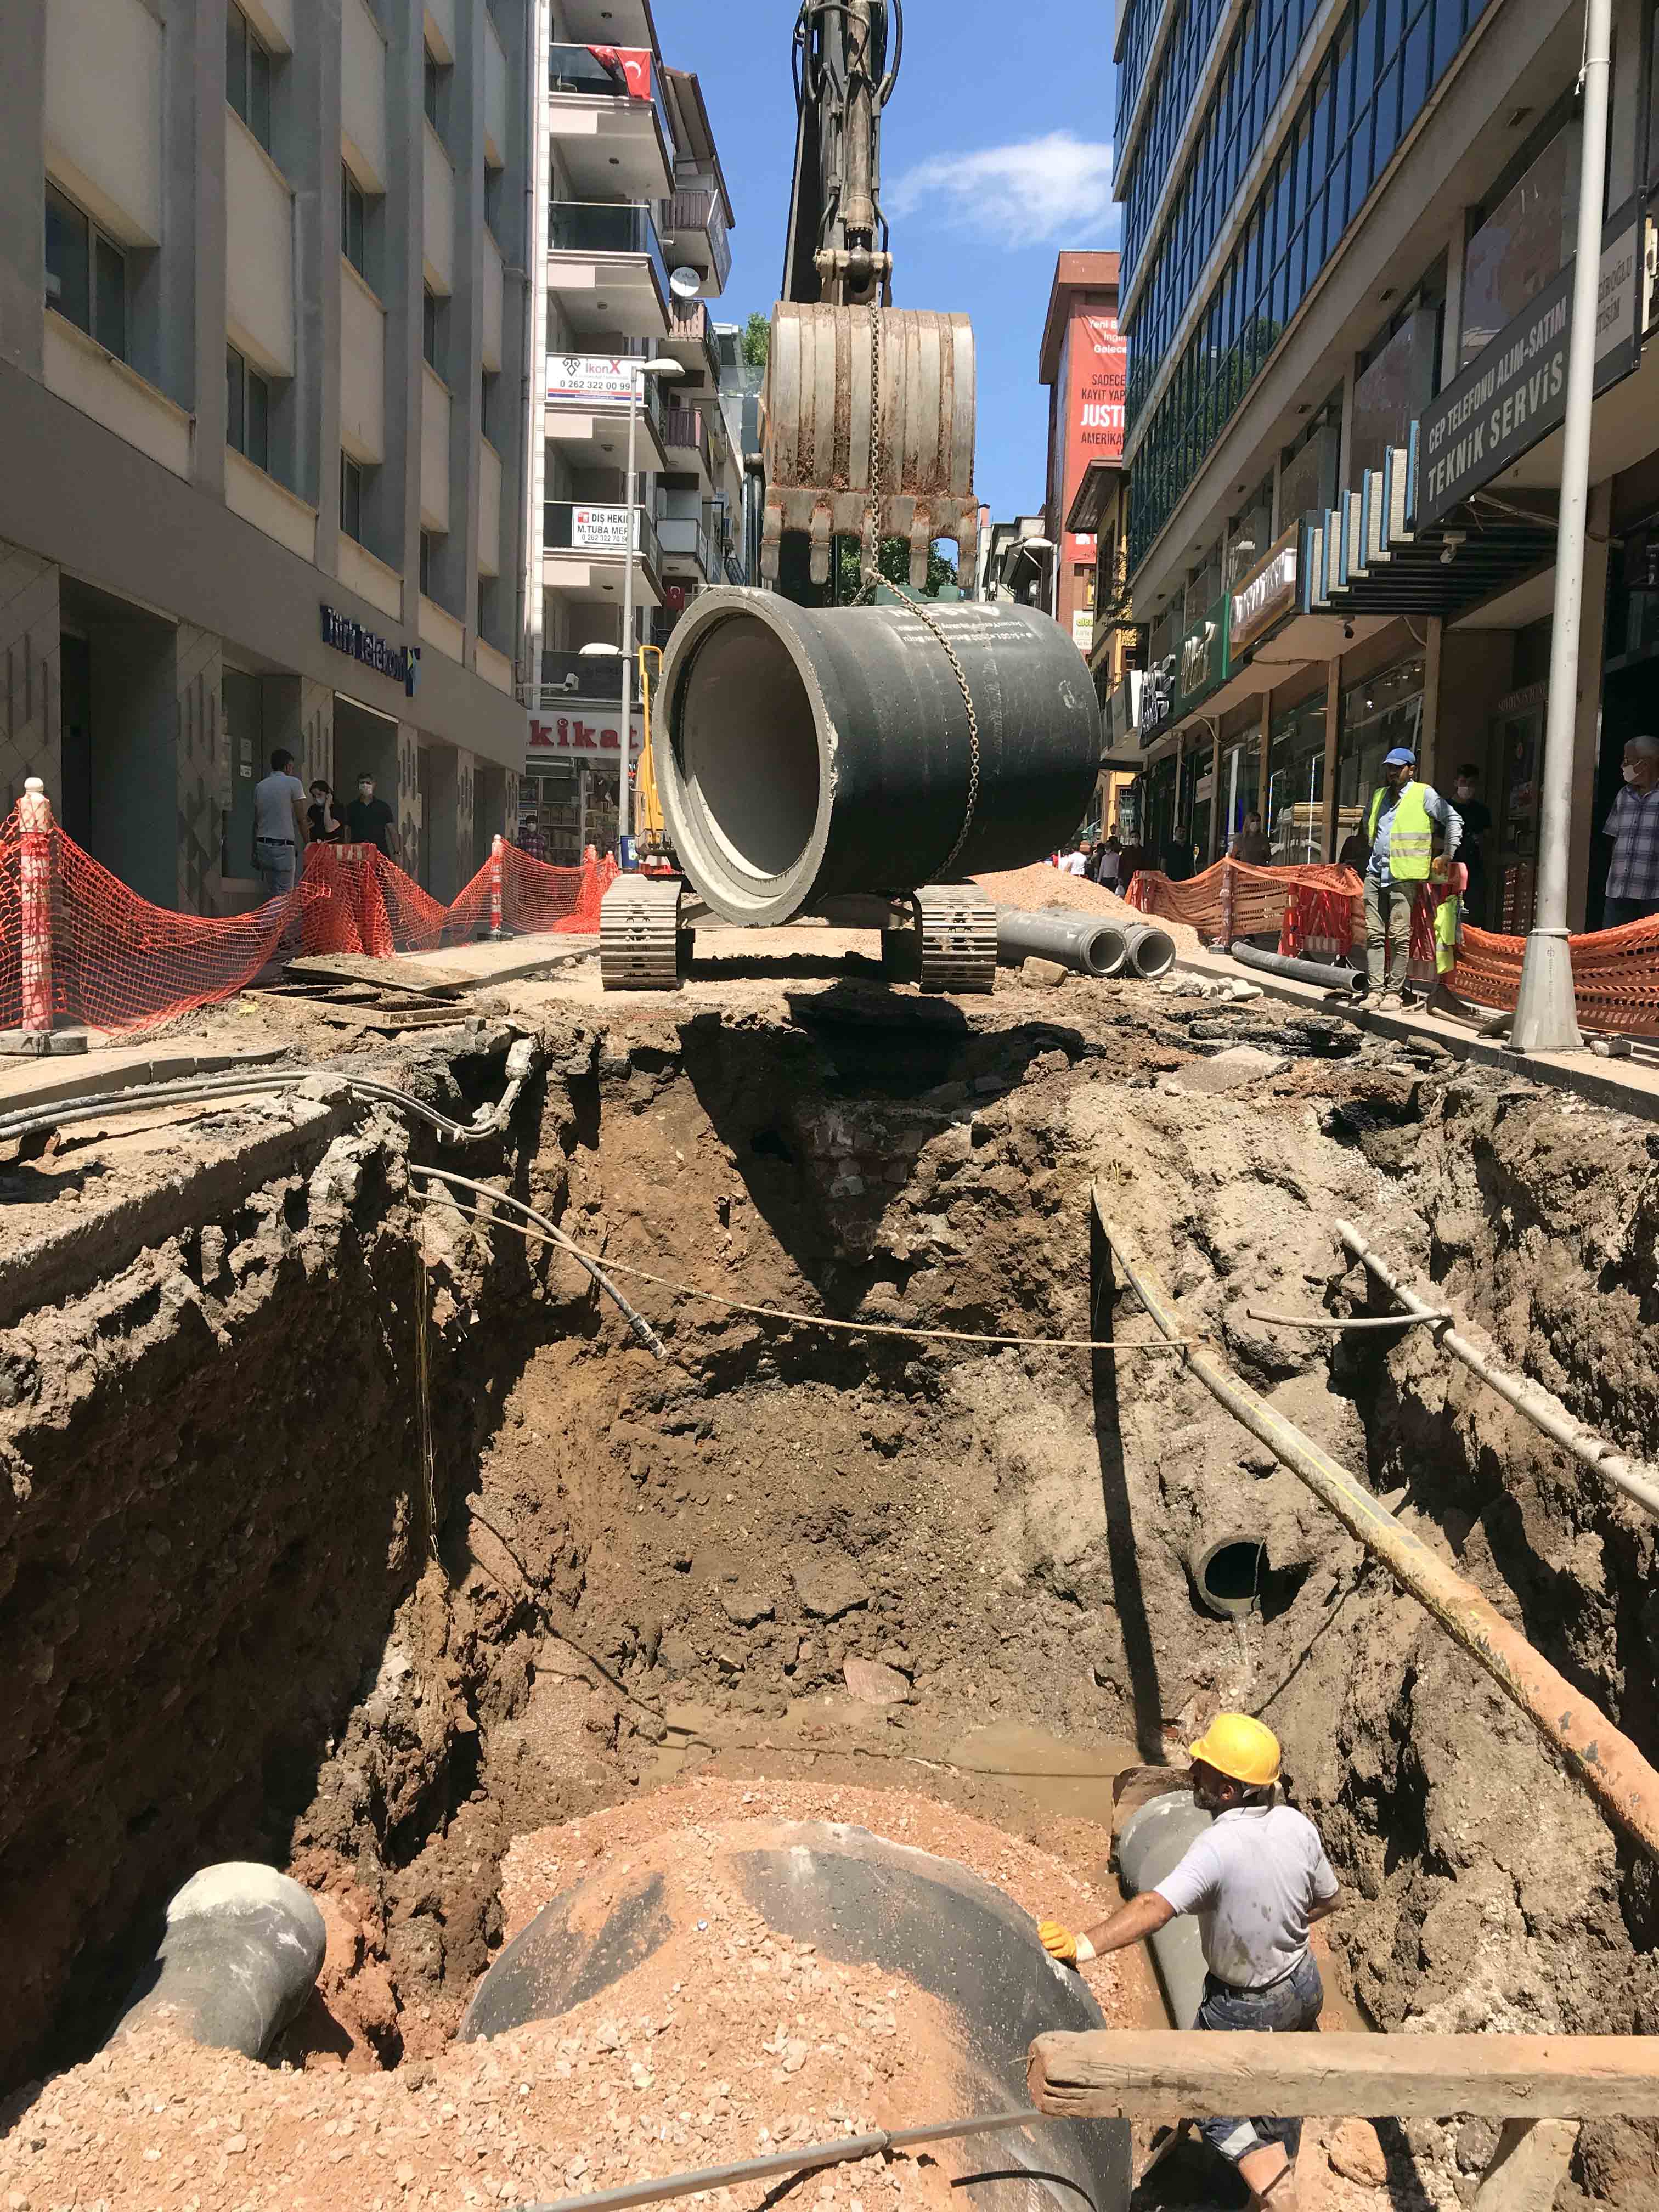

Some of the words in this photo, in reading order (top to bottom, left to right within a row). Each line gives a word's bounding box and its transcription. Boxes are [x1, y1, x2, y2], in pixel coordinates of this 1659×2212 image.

[1091, 374, 1126, 386] SADECE
[1429, 416, 1445, 454] CEP
[1448, 366, 1495, 435] TELEFONU
[592, 511, 605, 525] DİŞ
[527, 718, 639, 748] kikat
